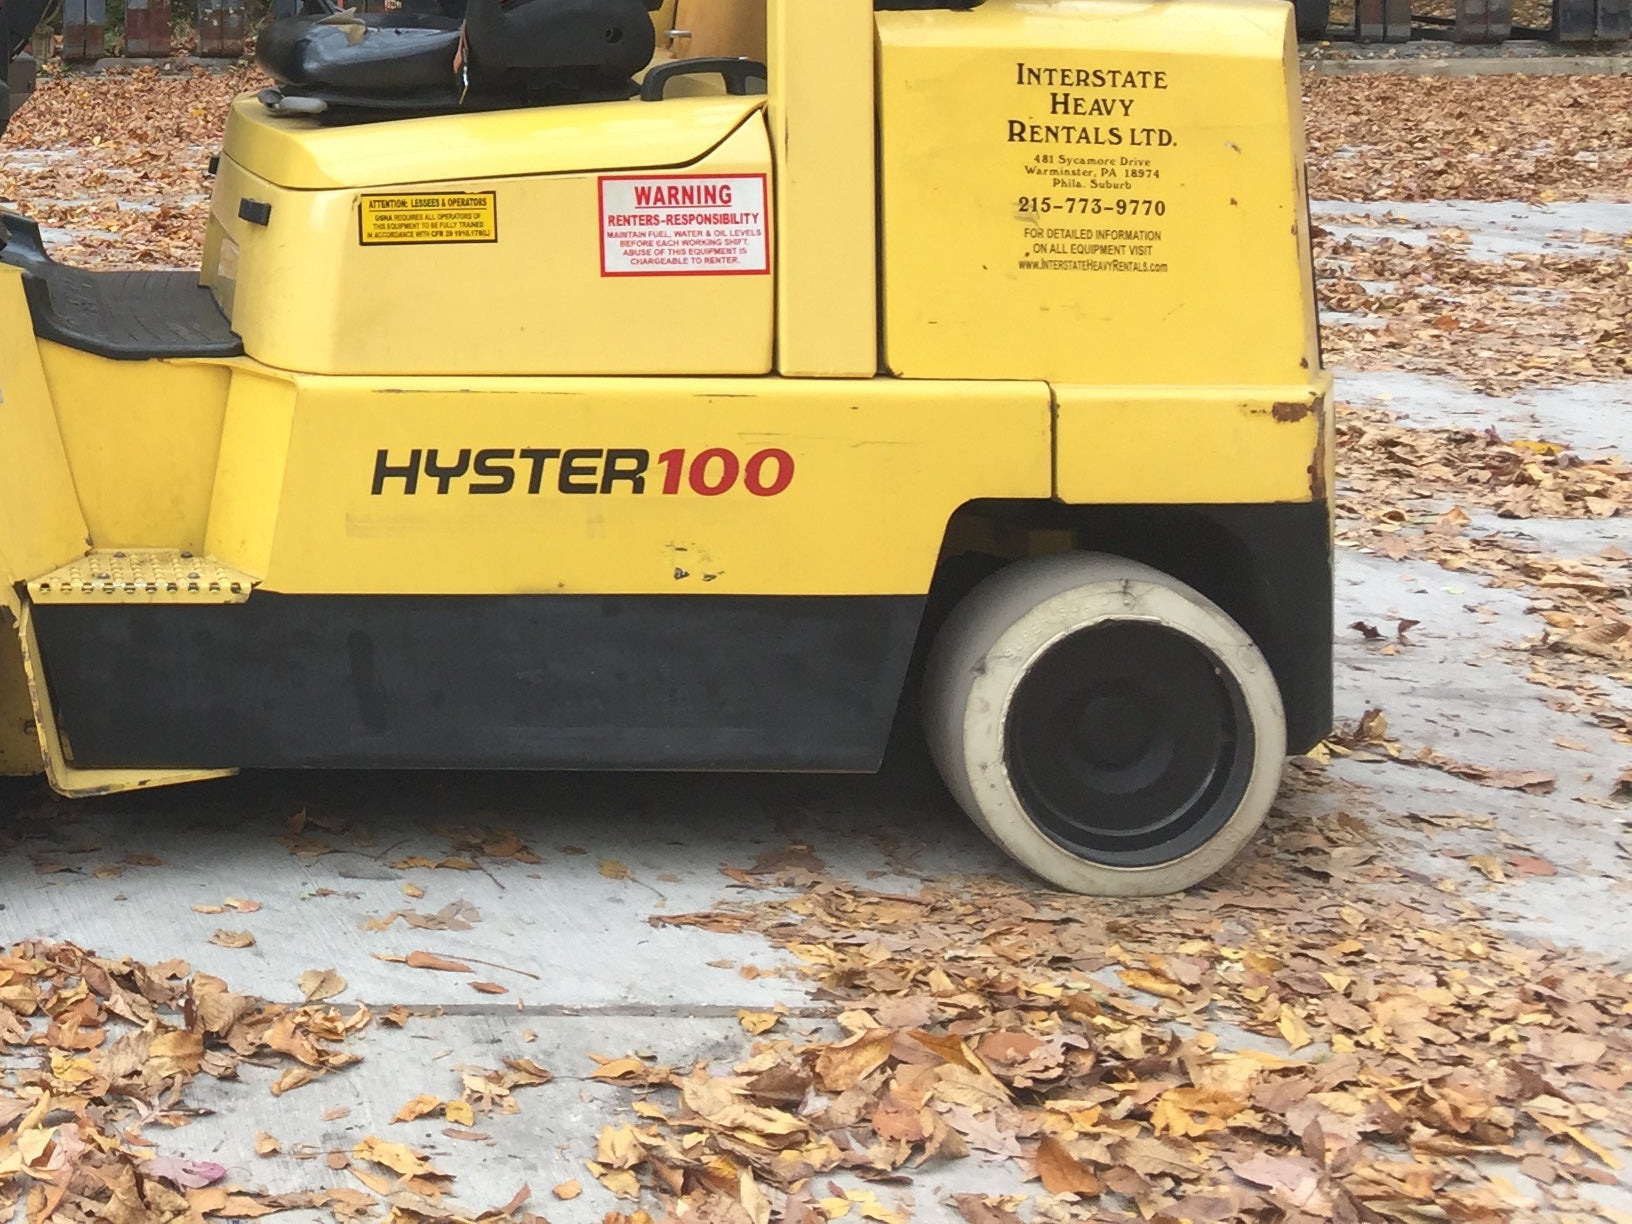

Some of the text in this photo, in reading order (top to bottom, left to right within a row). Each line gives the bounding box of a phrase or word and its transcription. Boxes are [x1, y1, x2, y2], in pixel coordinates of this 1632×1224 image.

[1016, 62, 1169, 90] INTERSTATE
[1049, 92, 1135, 117] HEAVY
[1006, 119, 1178, 147] RENTALS LTD.
[1033, 154, 1152, 167] 481 Sycamore Drive
[1024, 165, 1161, 179] Warminster, PA 18974
[1052, 177, 1132, 190] Phila. Suburb
[634, 184, 732, 205] WARNING
[447, 197, 487, 206] OPERATORS
[1018, 196, 1167, 217] 215-773-9770
[607, 231, 647, 239] MAINTAIN
[674, 230, 704, 238] WATER
[729, 229, 762, 237] LEVELS
[1024, 227, 1162, 241] FOR DETAILED INFORMATION
[620, 239, 654, 247] BEFORE
[656, 239, 680, 247] EACH
[681, 238, 722, 246] WORKING
[622, 248, 653, 256] ABUSE
[667, 248, 686, 256] THIS
[688, 247, 737, 255] EQUIPMENT
[1032, 243, 1154, 256] ON ALL EQUIPMENT VISIT
[630, 257, 689, 266] CHARGEABLE
[370, 447, 796, 497] HYSTER 100
